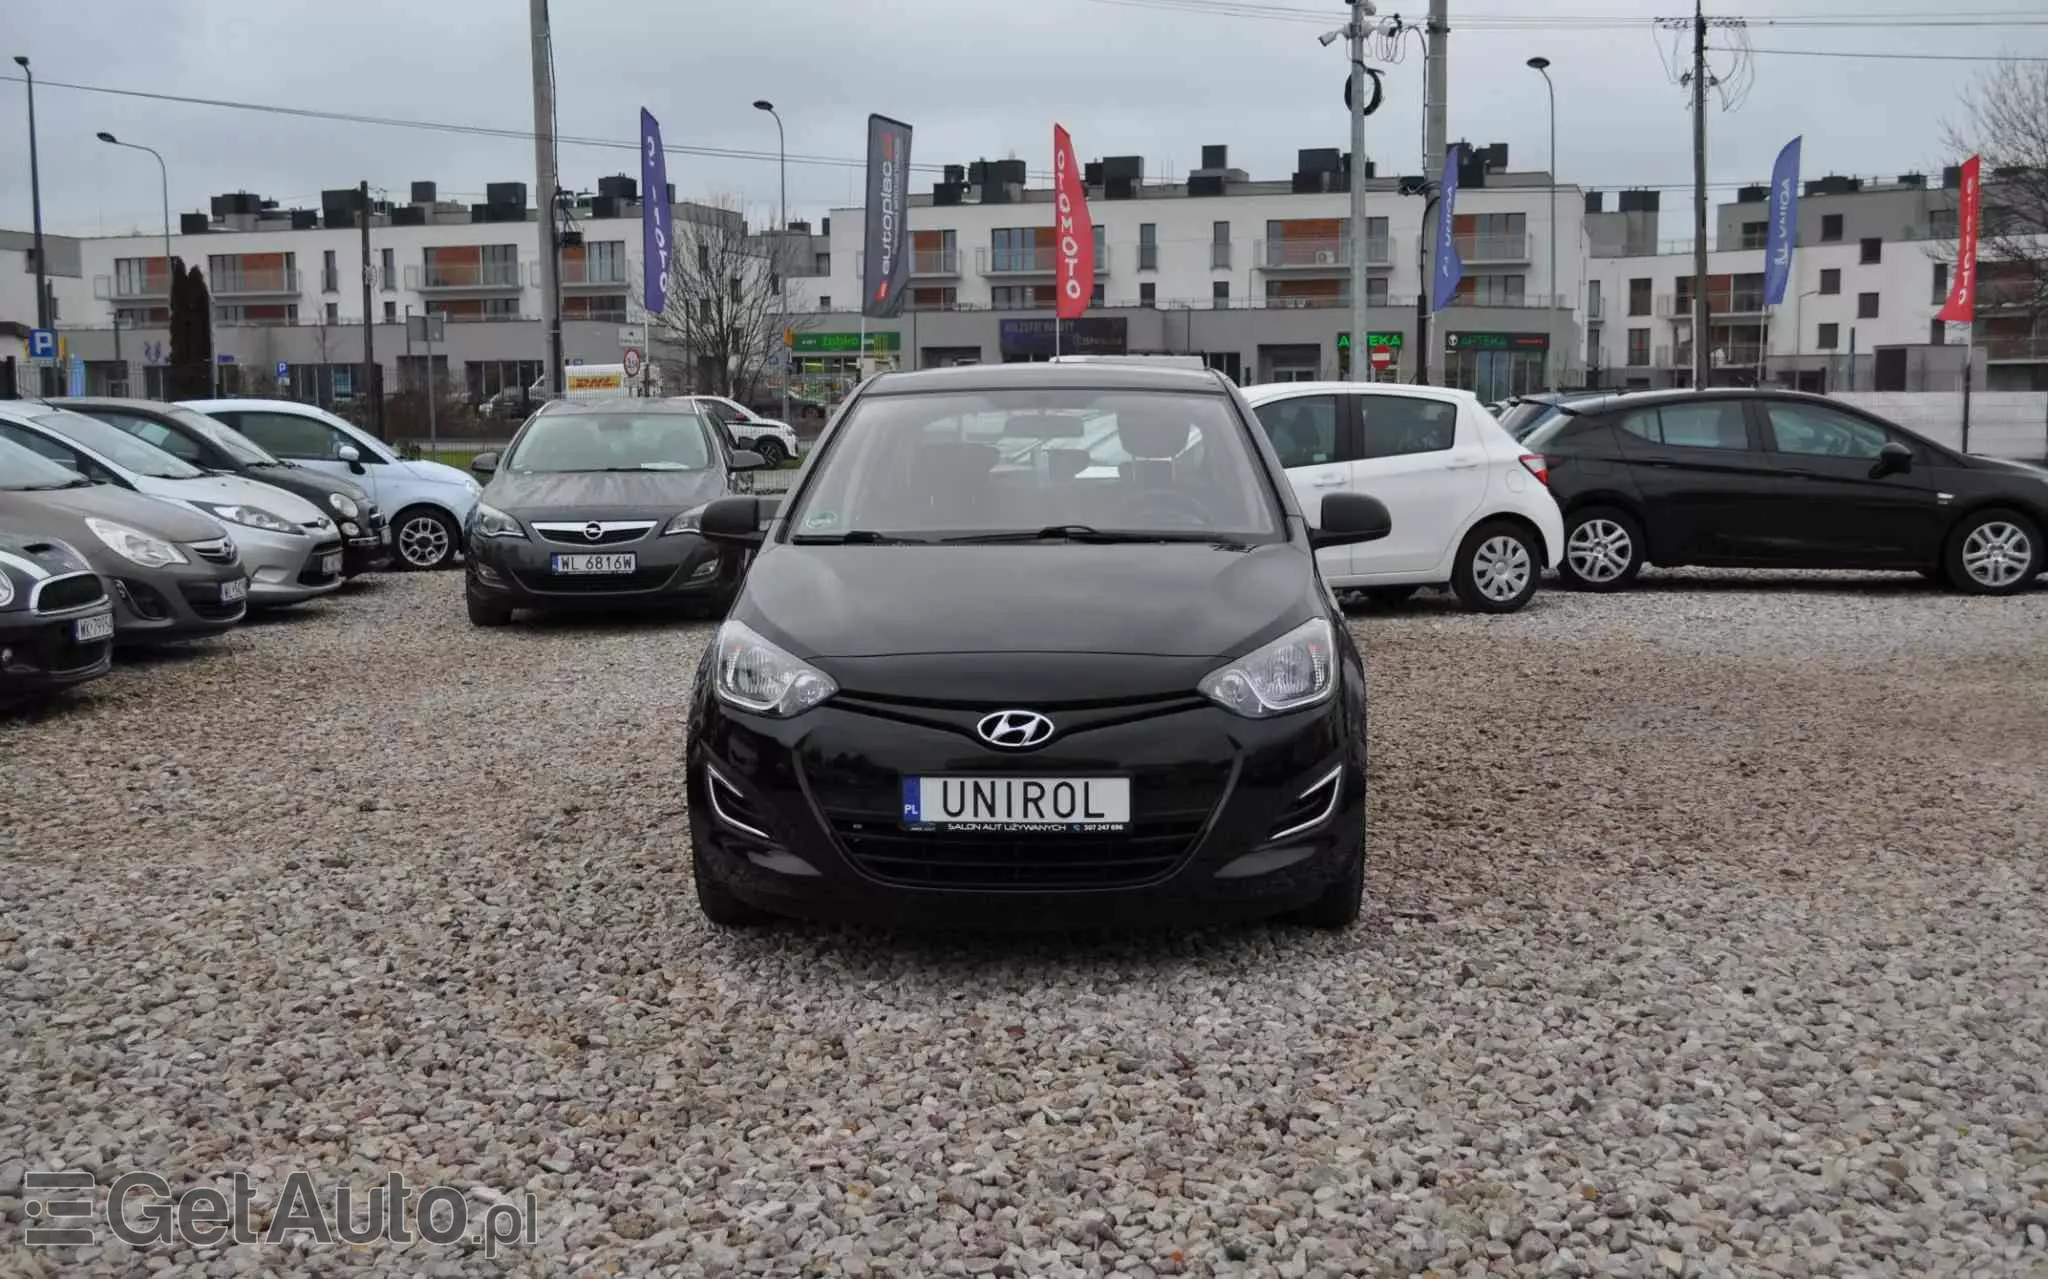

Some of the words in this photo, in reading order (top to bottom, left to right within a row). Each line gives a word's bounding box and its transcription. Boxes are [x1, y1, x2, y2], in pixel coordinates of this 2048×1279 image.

[1057, 149, 1082, 300] OTOMOTO
[34, 331, 53, 355] P
[1338, 335, 1402, 347] AEKA
[1460, 335, 1508, 347] APTEKA
[560, 555, 580, 570] WL
[585, 555, 632, 570] 6816W
[942, 780, 1105, 819] UNIROL
[904, 804, 919, 815] PL
